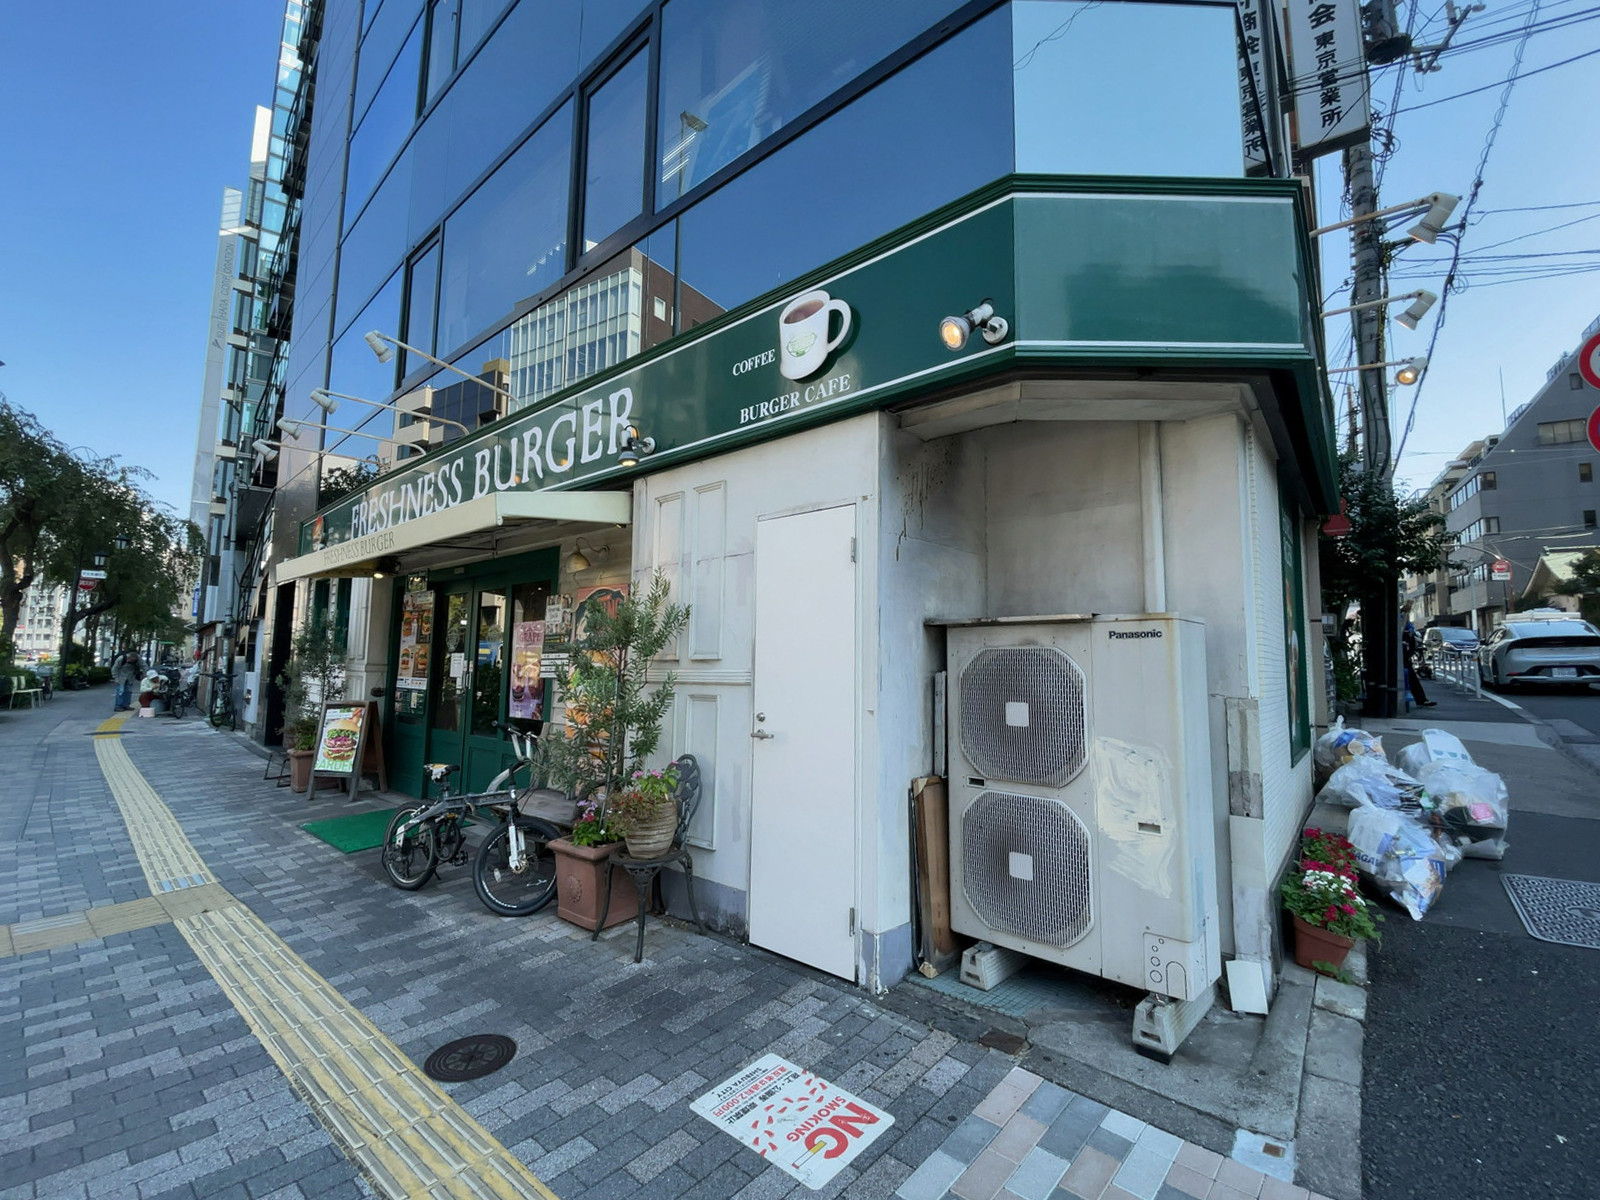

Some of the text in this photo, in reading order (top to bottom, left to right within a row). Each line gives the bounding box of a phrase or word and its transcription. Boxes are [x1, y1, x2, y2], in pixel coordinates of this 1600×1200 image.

[1314, 29, 1343, 129] 東京営業所
[732, 348, 776, 376] COFFEE
[739, 374, 851, 425] BURGER CAFE
[350, 387, 635, 541] FRESHNESS BURGER
[359, 531, 395, 557] BURGER
[1108, 629, 1162, 640] Panasonic
[733, 1067, 764, 1088] SHIBUYA
[716, 1085, 734, 1100] CITY
[786, 1095, 847, 1143] SMOKING
